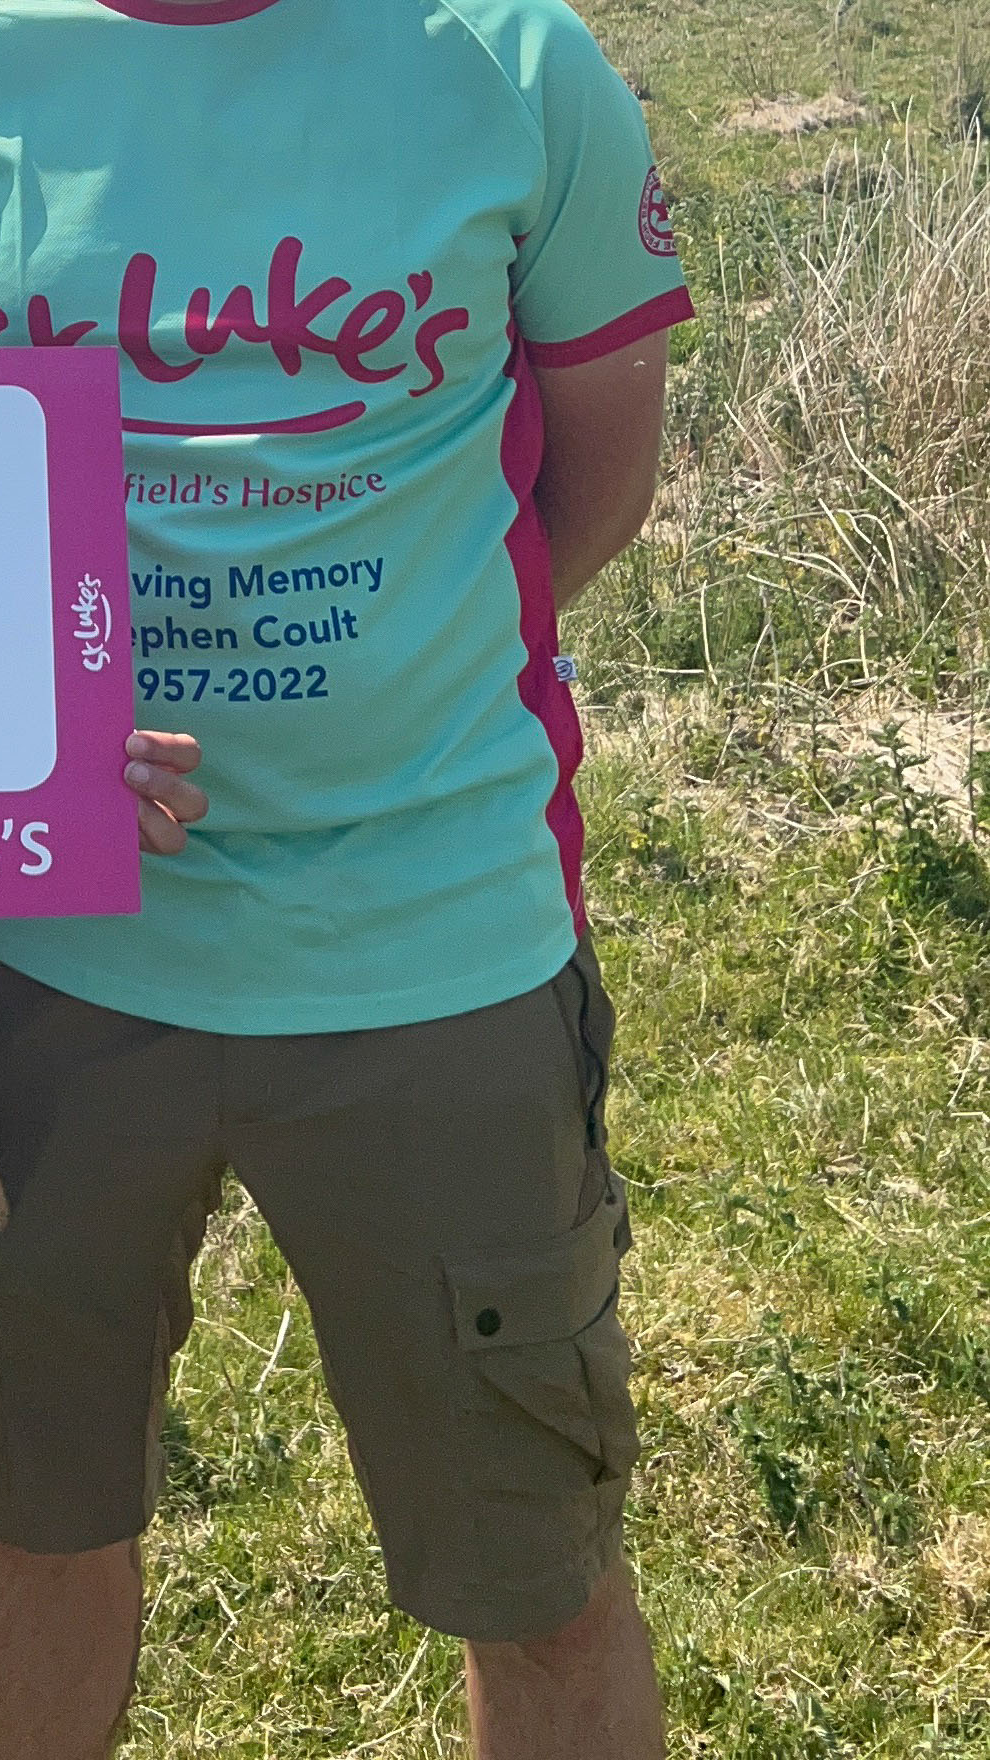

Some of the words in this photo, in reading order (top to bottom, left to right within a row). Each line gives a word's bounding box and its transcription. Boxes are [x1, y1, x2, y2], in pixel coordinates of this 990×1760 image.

[118, 237, 468, 396] Luke's
[241, 472, 387, 512] Hospice
[132, 564, 212, 609] ving
[228, 557, 384, 598] Memory
[252, 606, 359, 649] Coult
[137, 664, 329, 702] 957-2022
